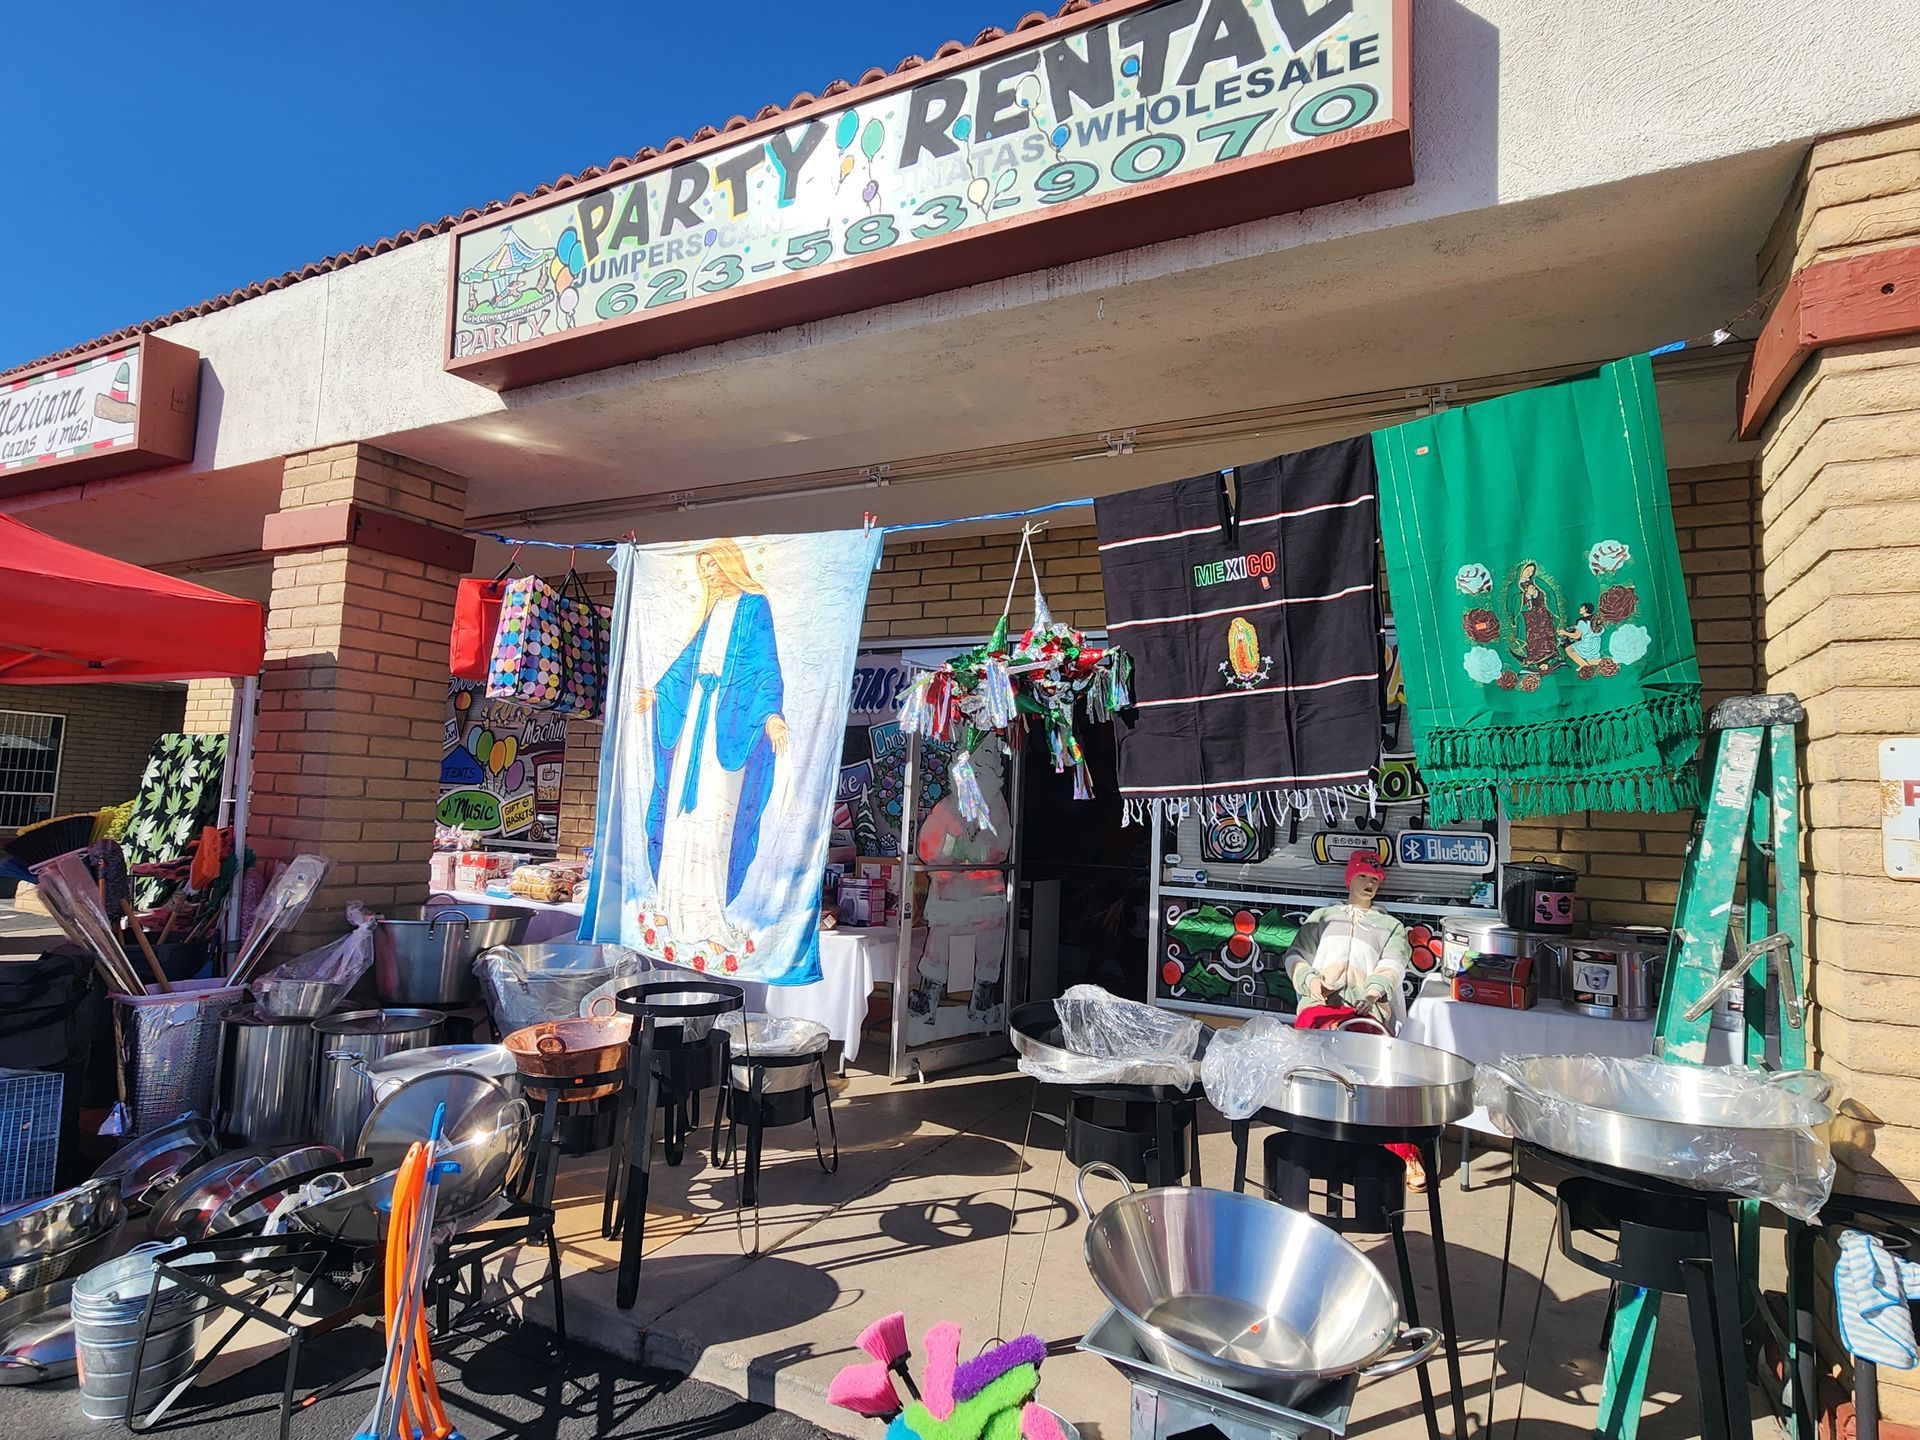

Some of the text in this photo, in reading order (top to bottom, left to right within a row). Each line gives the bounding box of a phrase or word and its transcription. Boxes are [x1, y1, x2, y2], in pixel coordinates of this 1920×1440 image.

[577, 0, 1354, 263] PARTY RENTAL
[573, 232, 702, 289] JUMPERS
[1075, 33, 1381, 148] WHOLESALE
[453, 309, 551, 359] PARTY
[2, 435, 38, 460] cazos
[45, 427, 59, 452] y
[1194, 551, 1276, 588] MEXICO
[445, 766, 475, 779] TENTS
[504, 803, 521, 816] GIFT
[506, 807, 534, 828] BASKETS
[1427, 838, 1488, 862] Bluetooth
